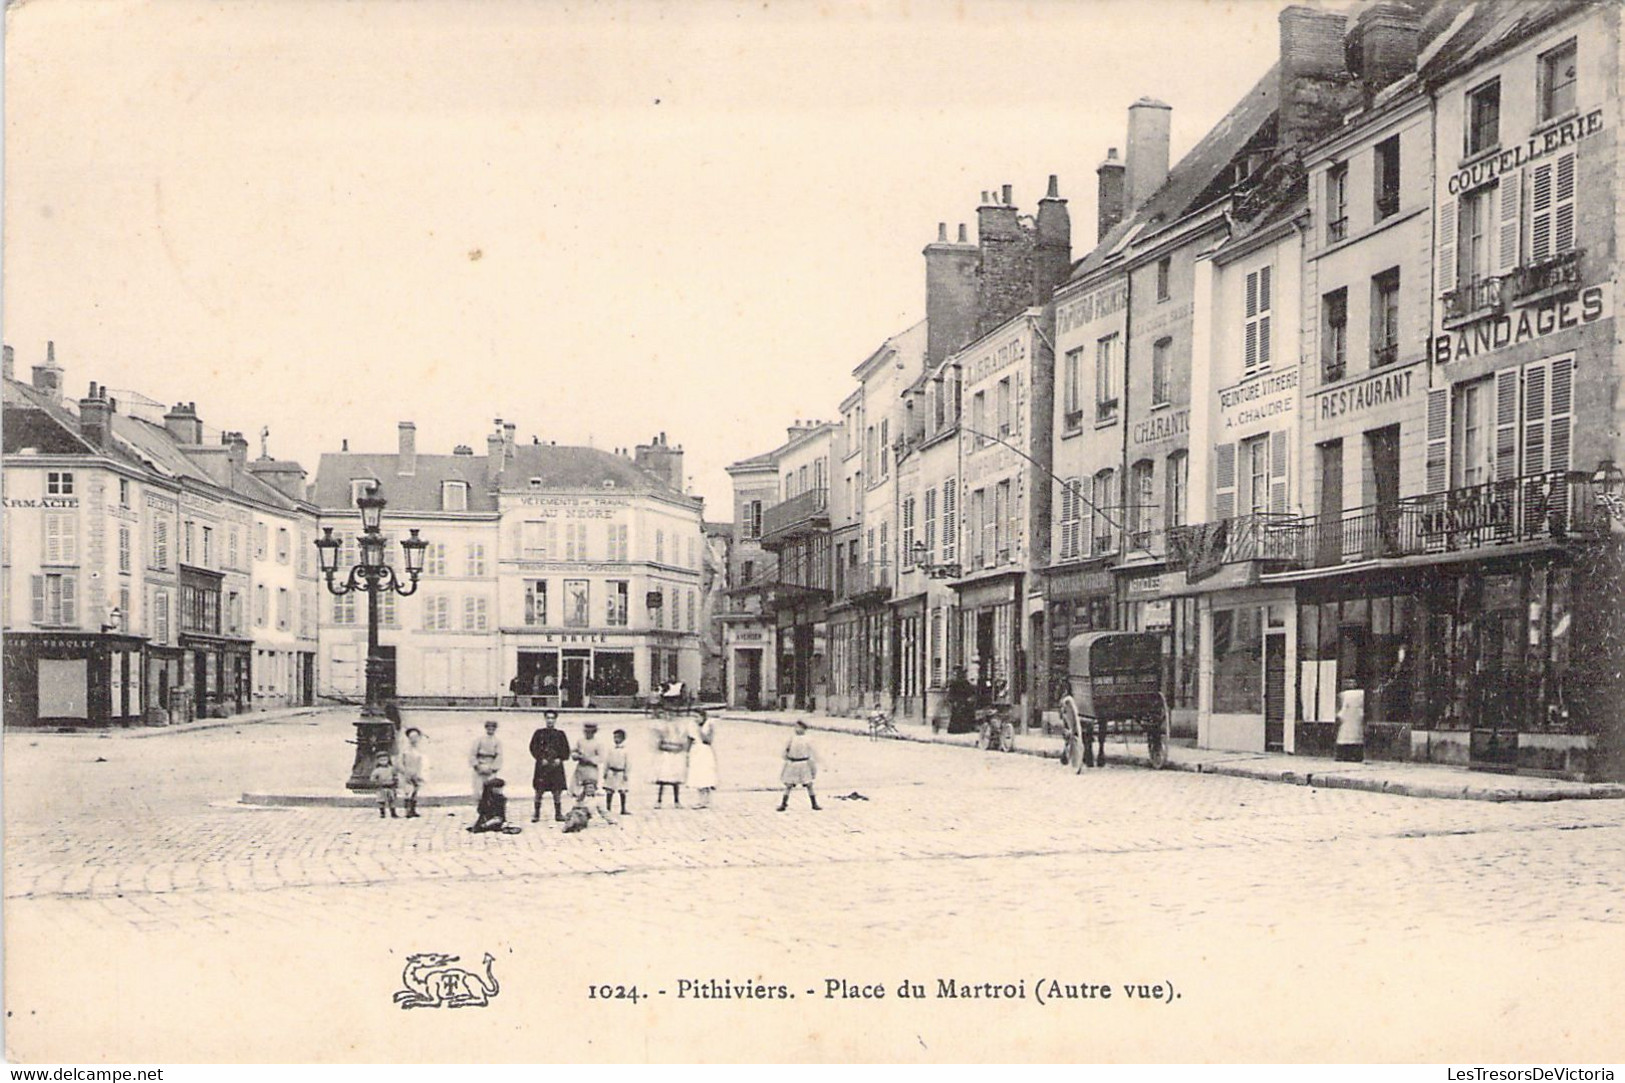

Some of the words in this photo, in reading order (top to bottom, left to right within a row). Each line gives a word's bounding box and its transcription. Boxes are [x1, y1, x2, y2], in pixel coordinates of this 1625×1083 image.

[1449, 109, 1604, 195] COUTELLERIE
[1435, 286, 1603, 365] BANDAGES
[1221, 383, 1260, 412] PEINTURE
[1262, 370, 1297, 395] VITRERIE
[1238, 397, 1293, 424] CHAUDRE
[1321, 370, 1412, 420] RESTAURANT
